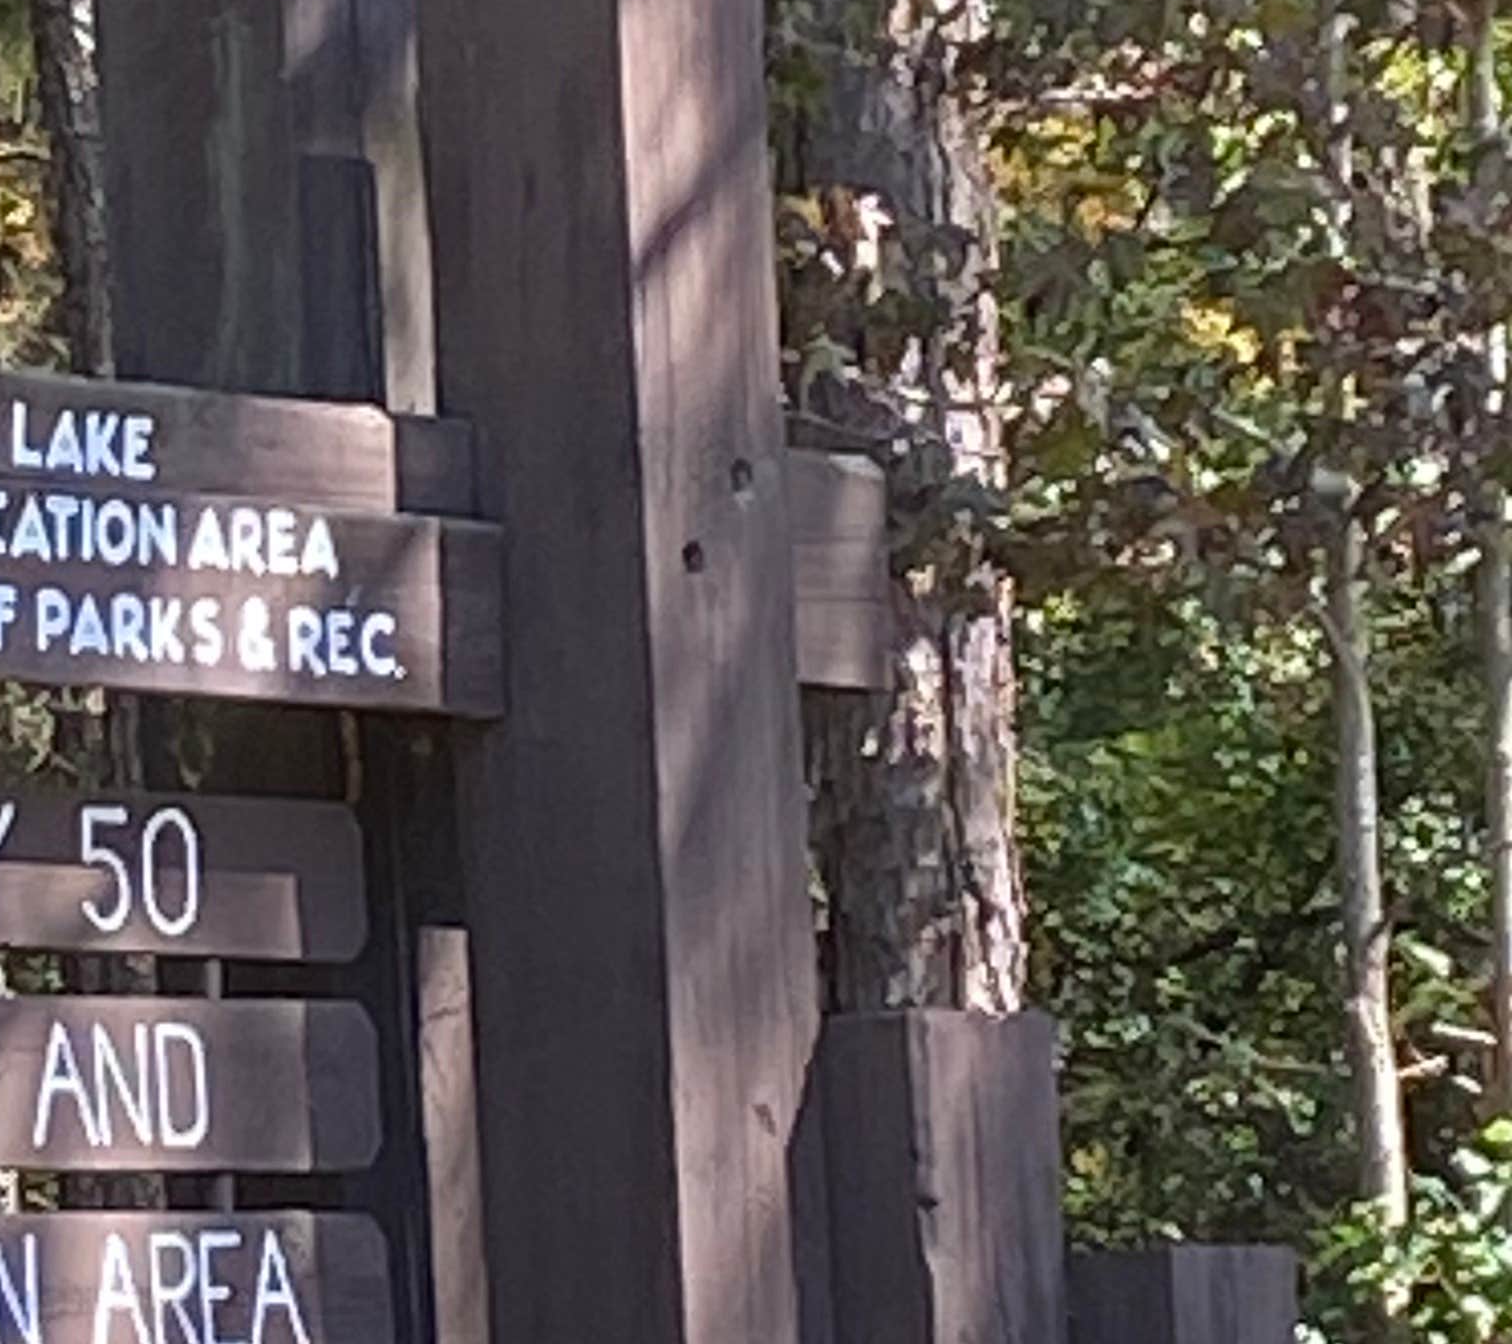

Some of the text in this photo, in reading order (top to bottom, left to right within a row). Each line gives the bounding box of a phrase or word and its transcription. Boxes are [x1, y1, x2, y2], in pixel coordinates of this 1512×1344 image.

[12, 404, 156, 480] LAKE
[189, 510, 337, 579] AREA
[37, 597, 222, 666] PARKS
[236, 599, 276, 669] &
[290, 612, 406, 678] REC.
[81, 806, 199, 936] 50
[33, 1022, 208, 1148] AND
